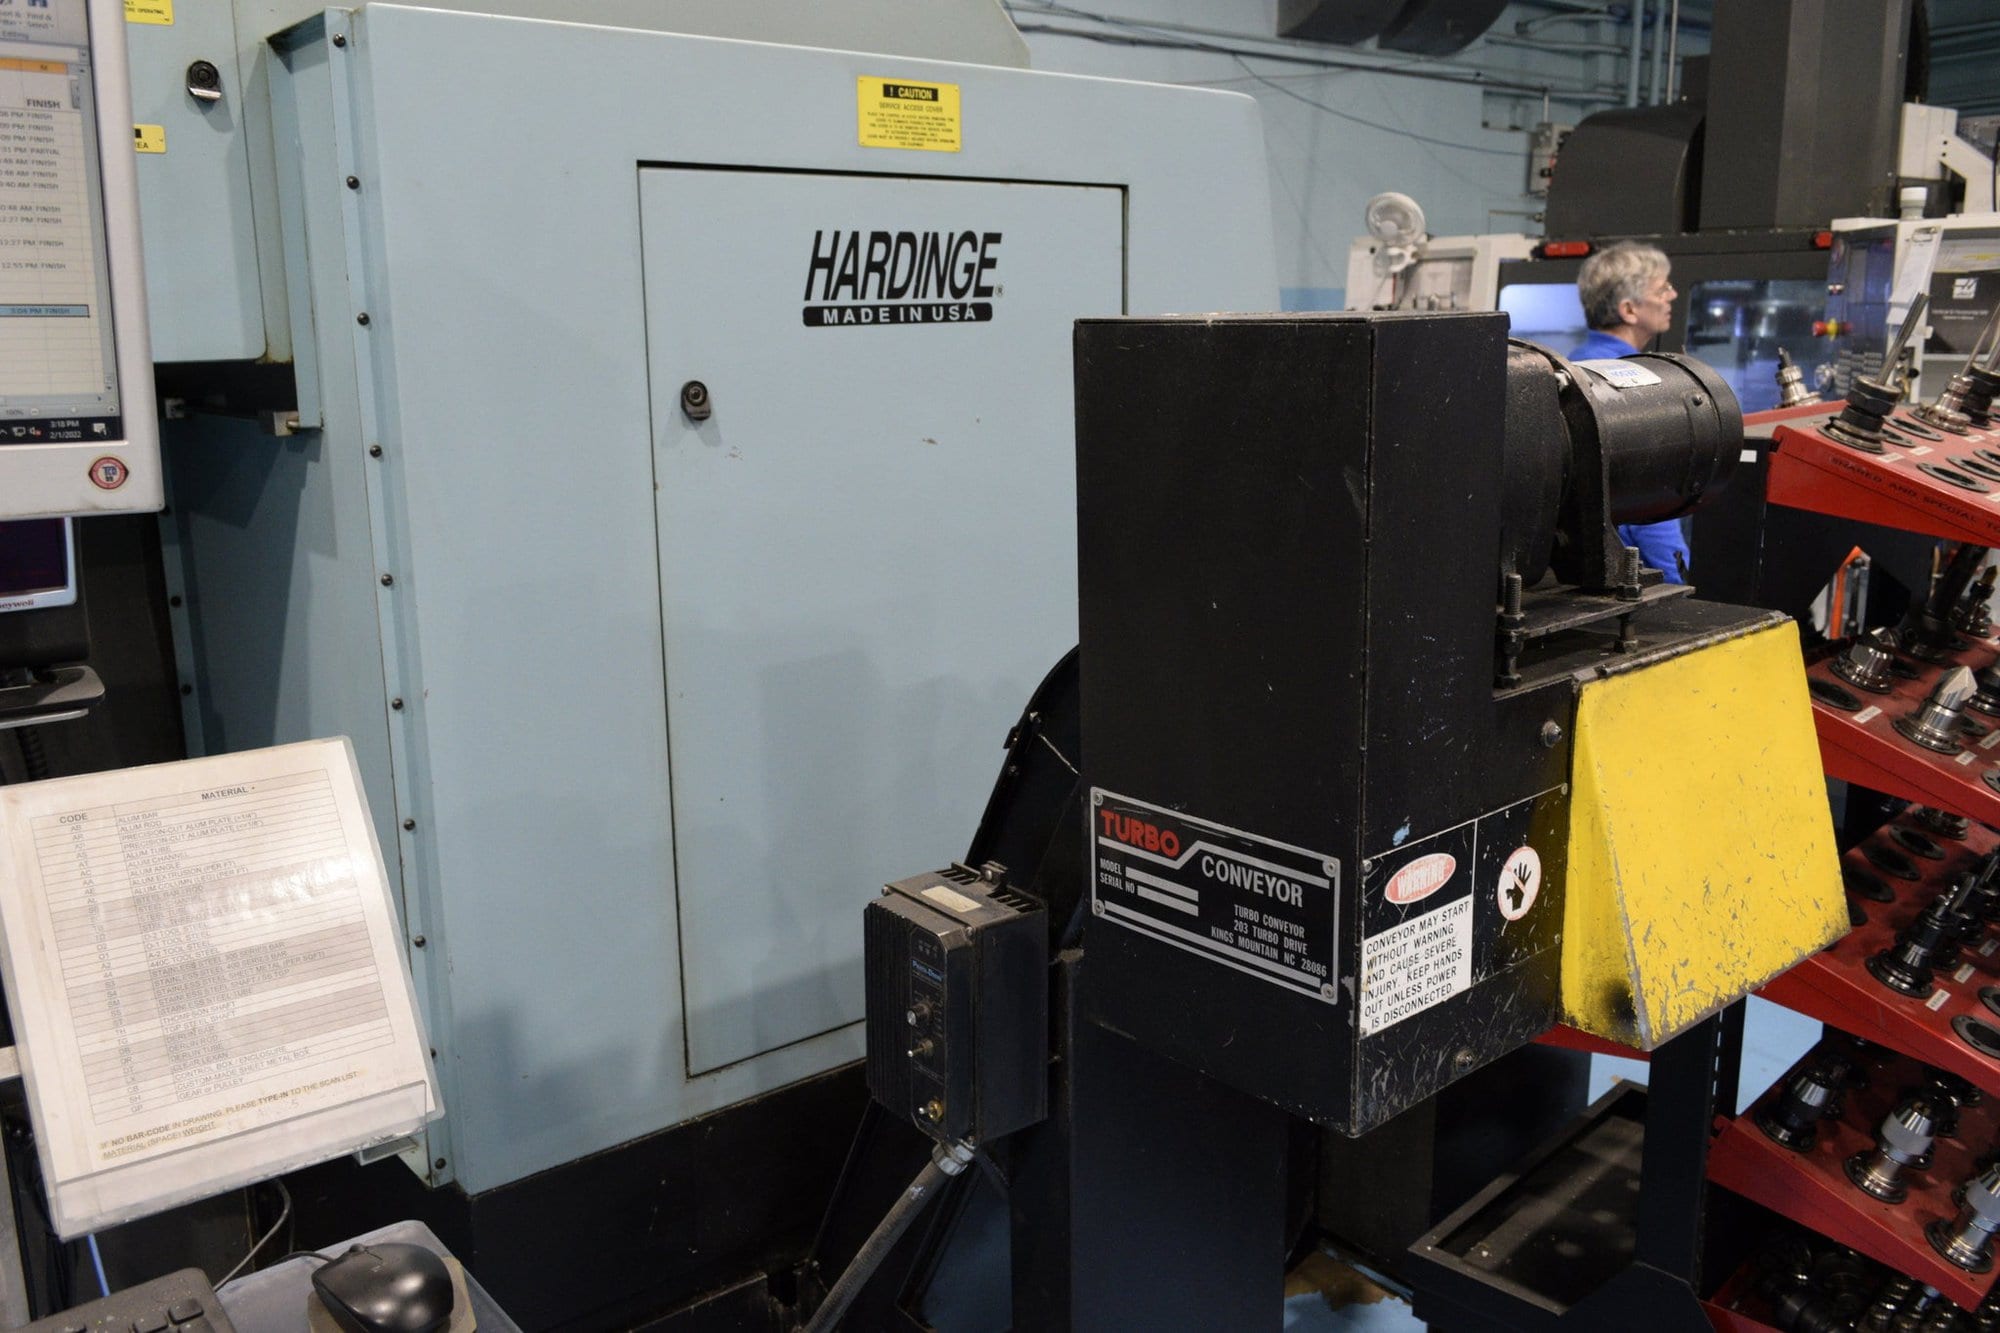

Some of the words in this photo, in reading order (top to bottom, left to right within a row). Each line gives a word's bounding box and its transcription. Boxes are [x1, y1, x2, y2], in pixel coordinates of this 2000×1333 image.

[27, 99, 61, 109] FINISH
[898, 87, 933, 100] CAUTION
[804, 230, 1002, 302] HARDINGE
[823, 308, 890, 324] MADE
[900, 306, 922, 323] IN
[932, 304, 976, 322] USA
[50, 430, 82, 438] 2/1/2022
[1830, 456, 1883, 483] SHARED
[1888, 482, 1918, 498] AND
[1923, 495, 1977, 523] SPECIAL
[58, 813, 87, 823] CODE
[201, 786, 248, 799] MATERIAL
[1100, 810, 1180, 857] TURBO
[1100, 858, 1122, 876] MODEL
[1100, 872, 1122, 890] SERIAL
[1126, 880, 1134, 894] NO
[1202, 855, 1303, 908] CONVEYOR
[1234, 904, 1259, 924] TURBO
[1262, 914, 1305, 938] CONVEYOR
[1234, 920, 1248, 934] 203
[1252, 924, 1278, 944] TURBO
[1284, 934, 1308, 956] DRIVE
[1366, 923, 1416, 955] CONVEYOR
[1418, 915, 1438, 932] MAY
[1442, 900, 1470, 923] START
[1211, 926, 1234, 944] KINGS
[1238, 934, 1278, 960] MOUNTAIN
[1284, 952, 1296, 966] NC
[1301, 959, 1327, 978] 28086
[1366, 944, 1408, 971] WITHOUT
[1414, 923, 1454, 950] WARNING
[1366, 968, 1386, 986] AND
[1390, 954, 1420, 976] CAUSE
[1424, 936, 1456, 960] SEVERE
[1364, 1000, 1384, 1018] OUT
[1388, 983, 1422, 1008] UNLESS
[1426, 966, 1456, 988] POWER
[1365, 981, 1400, 1002] INJURY.
[1406, 964, 1430, 982] KEEP
[1434, 950, 1462, 972] HANDS
[1371, 1016, 1380, 1028] IS
[1384, 983, 1454, 1024] DISCONNECTED.
[110, 1136, 124, 1146] NO
[126, 1123, 170, 1141] BAR-CODE
[172, 1120, 181, 1128] IN
[225, 1100, 254, 1114] PLEASE
[258, 1090, 288, 1104] TYPE-IN
[290, 1087, 301, 1095] TO
[303, 1082, 318, 1092] THE
[318, 1076, 340, 1087] SCAN
[341, 1071, 359, 1081] LIST
[103, 1141, 145, 1158] MATERIAL
[183, 1121, 216, 1136] WEIGHT
